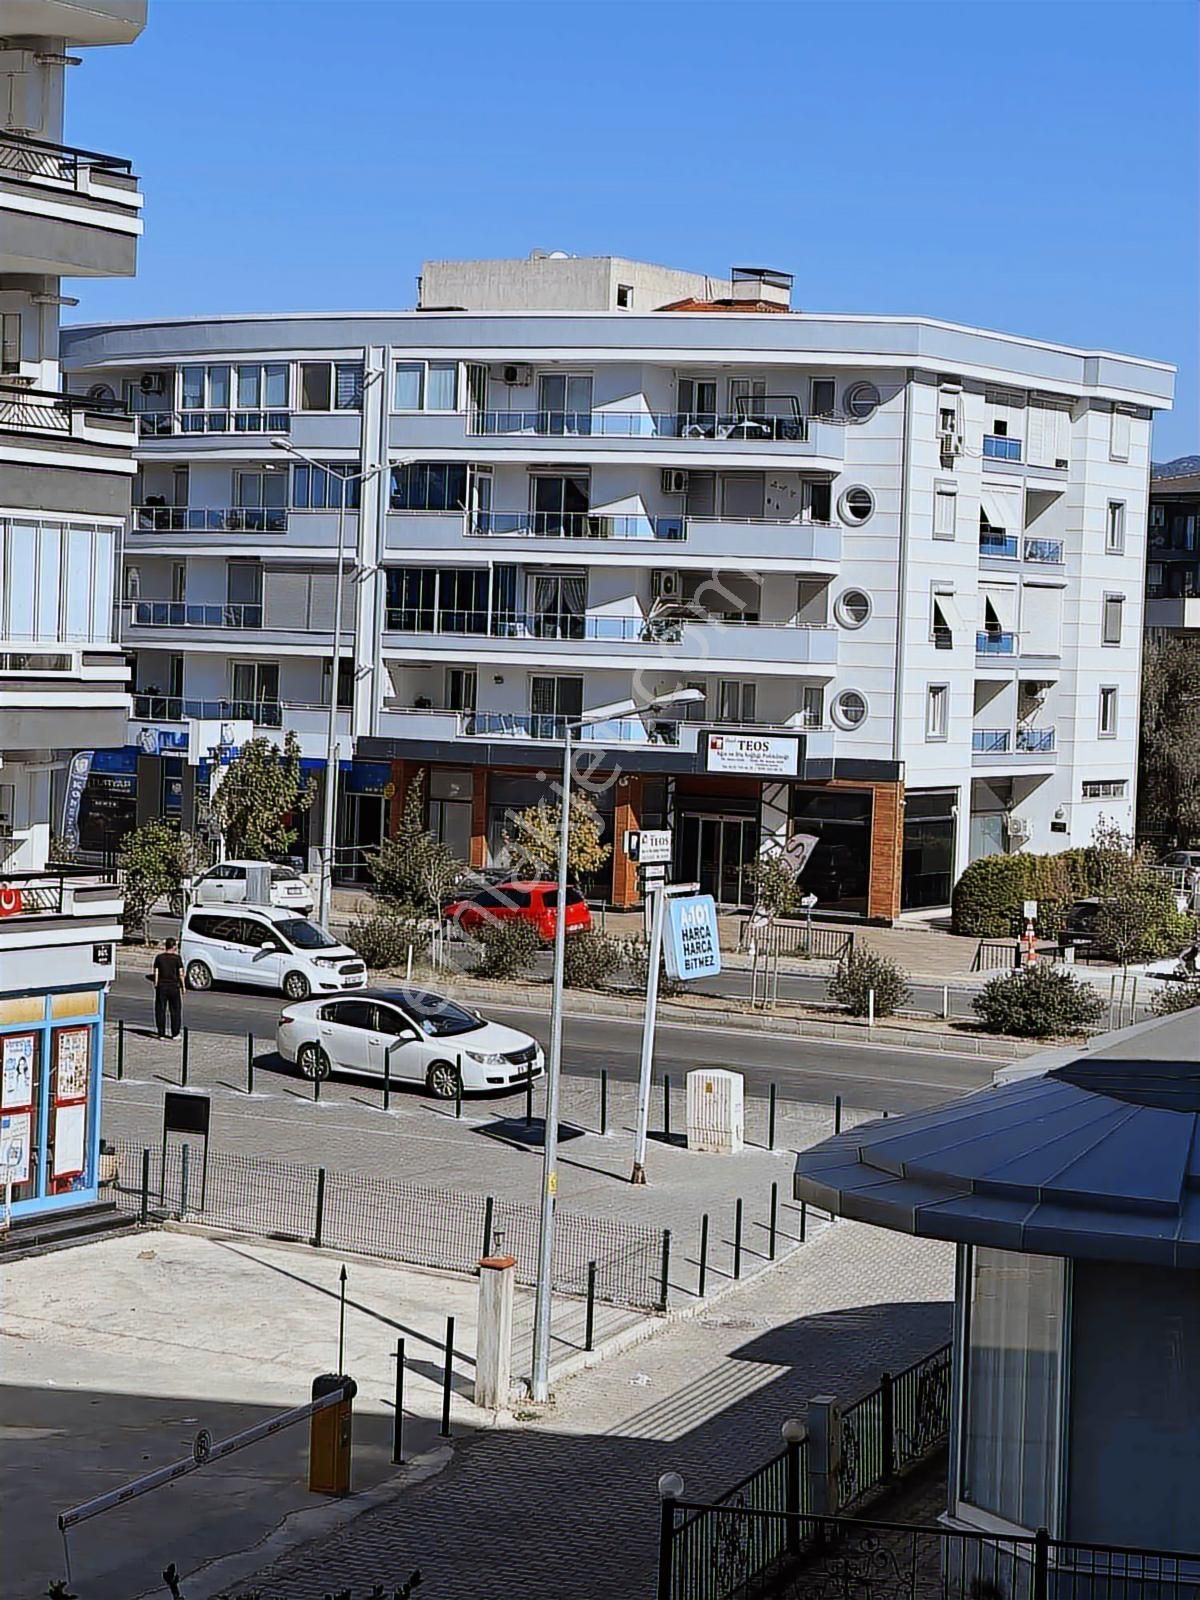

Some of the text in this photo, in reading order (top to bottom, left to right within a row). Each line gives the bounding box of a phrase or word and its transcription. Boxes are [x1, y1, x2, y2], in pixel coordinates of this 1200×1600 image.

[737, 740, 770, 751] TEOS
[682, 925, 711, 942] HARCA
[683, 940, 713, 957] HARCA
